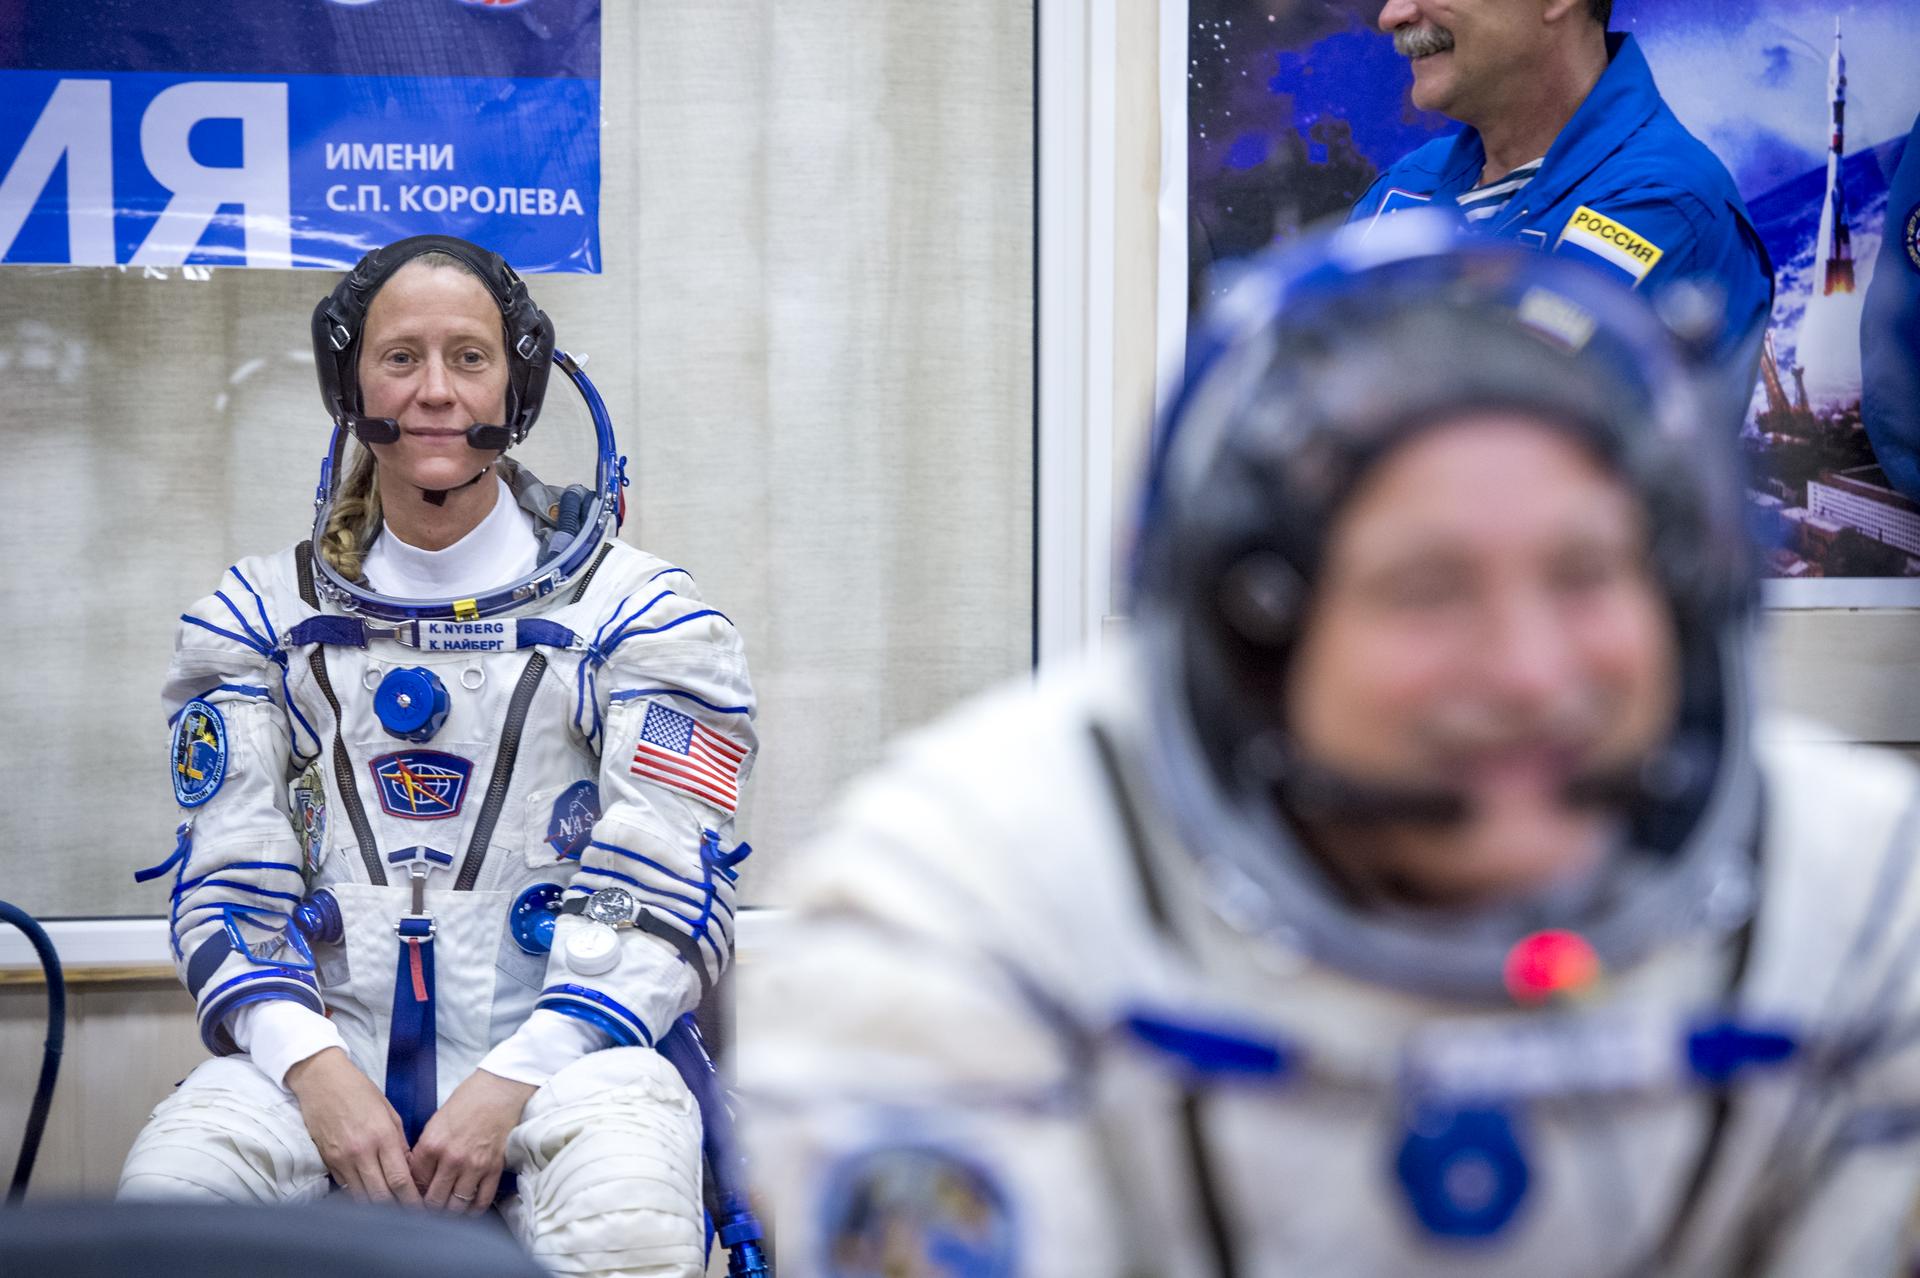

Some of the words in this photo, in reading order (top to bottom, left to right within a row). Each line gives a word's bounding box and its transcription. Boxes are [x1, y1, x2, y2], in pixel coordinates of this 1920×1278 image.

[325, 143, 454, 171] ИМЕНИ
[326, 184, 391, 212] С.П.
[400, 185, 584, 215] КОРОЛЕВА
[1574, 213, 1655, 263] РОССИЯ
[429, 623, 441, 634] K.
[444, 623, 504, 634] NYBERG
[443, 638, 505, 650] НАЙБЕРГ
[559, 812, 594, 837] NAS
